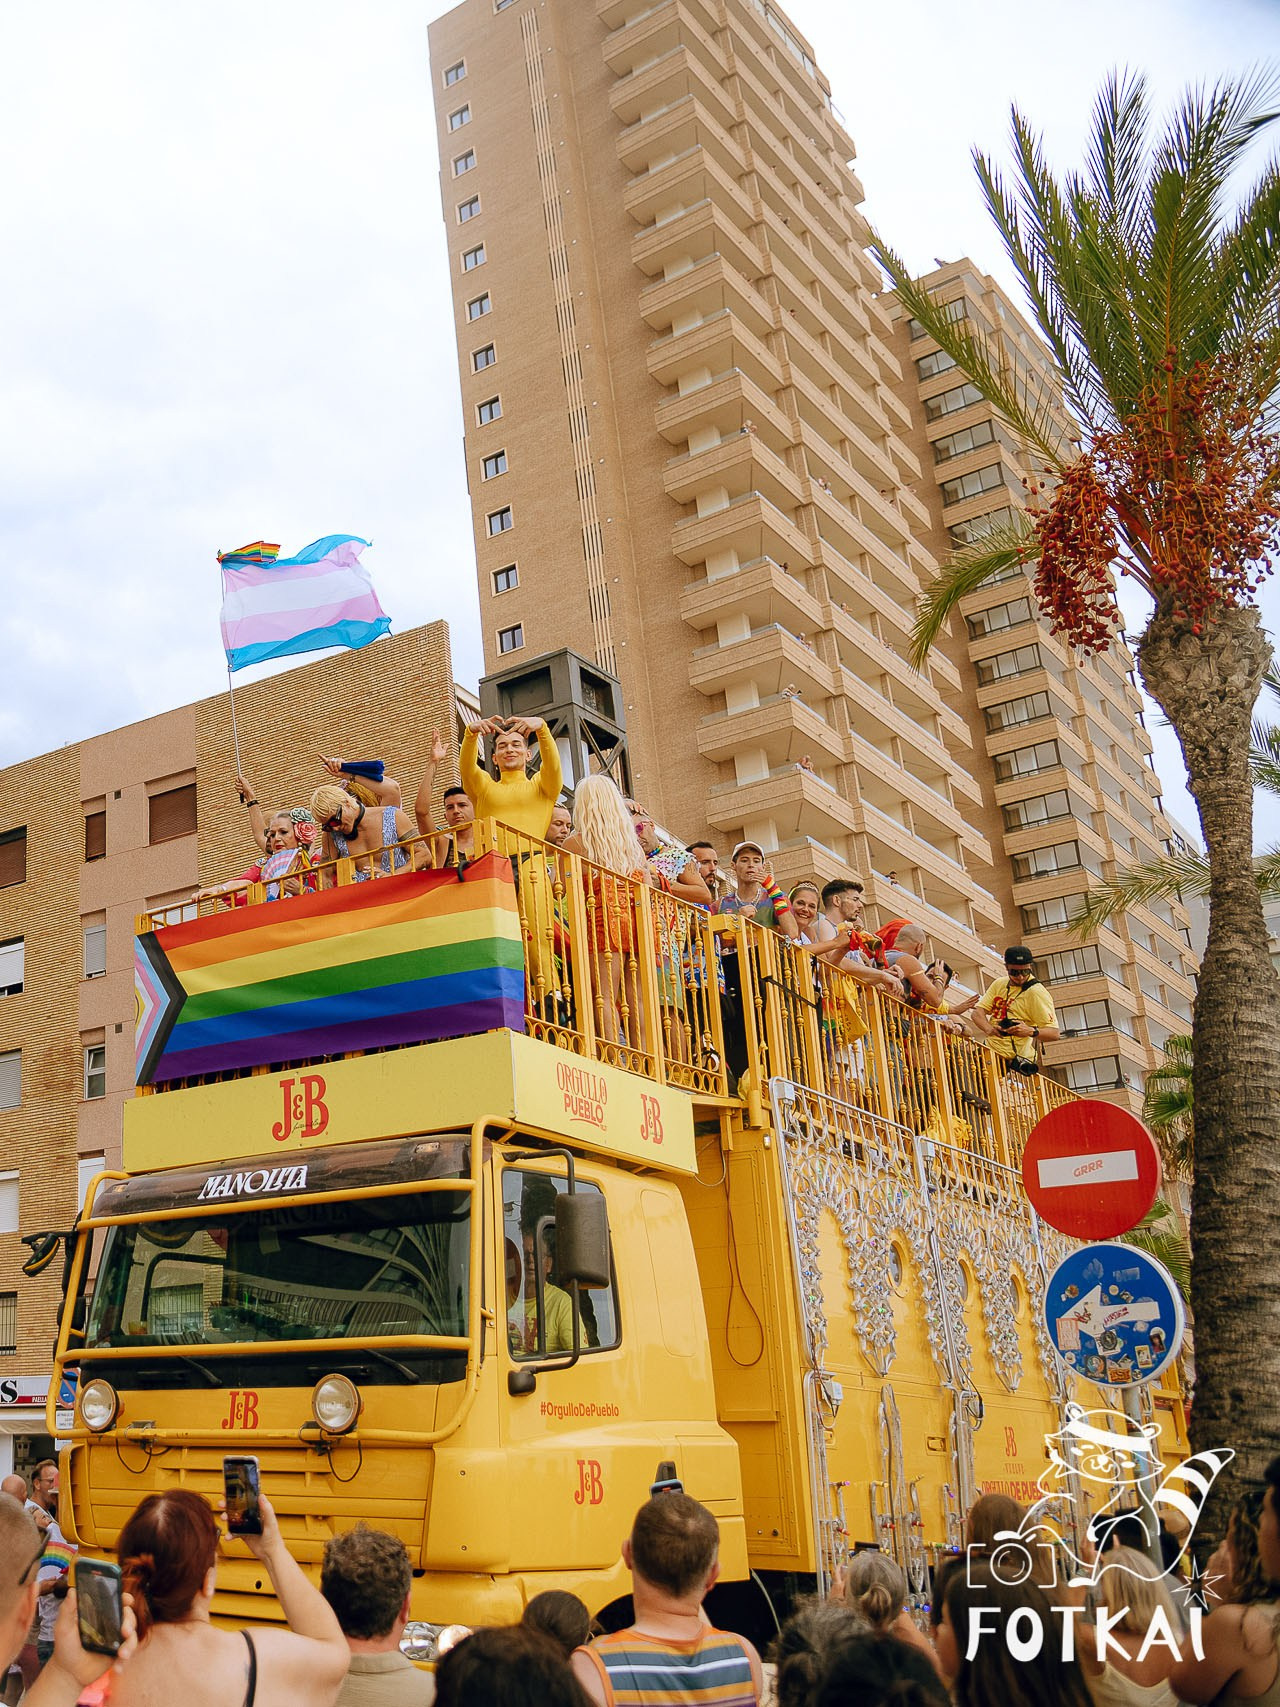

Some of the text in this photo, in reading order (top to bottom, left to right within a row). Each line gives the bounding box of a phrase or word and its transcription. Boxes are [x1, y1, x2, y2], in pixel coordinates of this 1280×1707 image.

[556, 1062, 608, 1105] ORGULLO
[271, 1074, 330, 1142] J&B
[563, 1093, 604, 1124] PUEBLO
[640, 1093, 664, 1145] J&B
[197, 1164, 309, 1200] MANOLITA
[1073, 1159, 1104, 1178] GRRR
[221, 1390, 259, 1430] J&B
[540, 1401, 619, 1420] #OrgulloDePueblo
[574, 1459, 604, 1505] J&B
